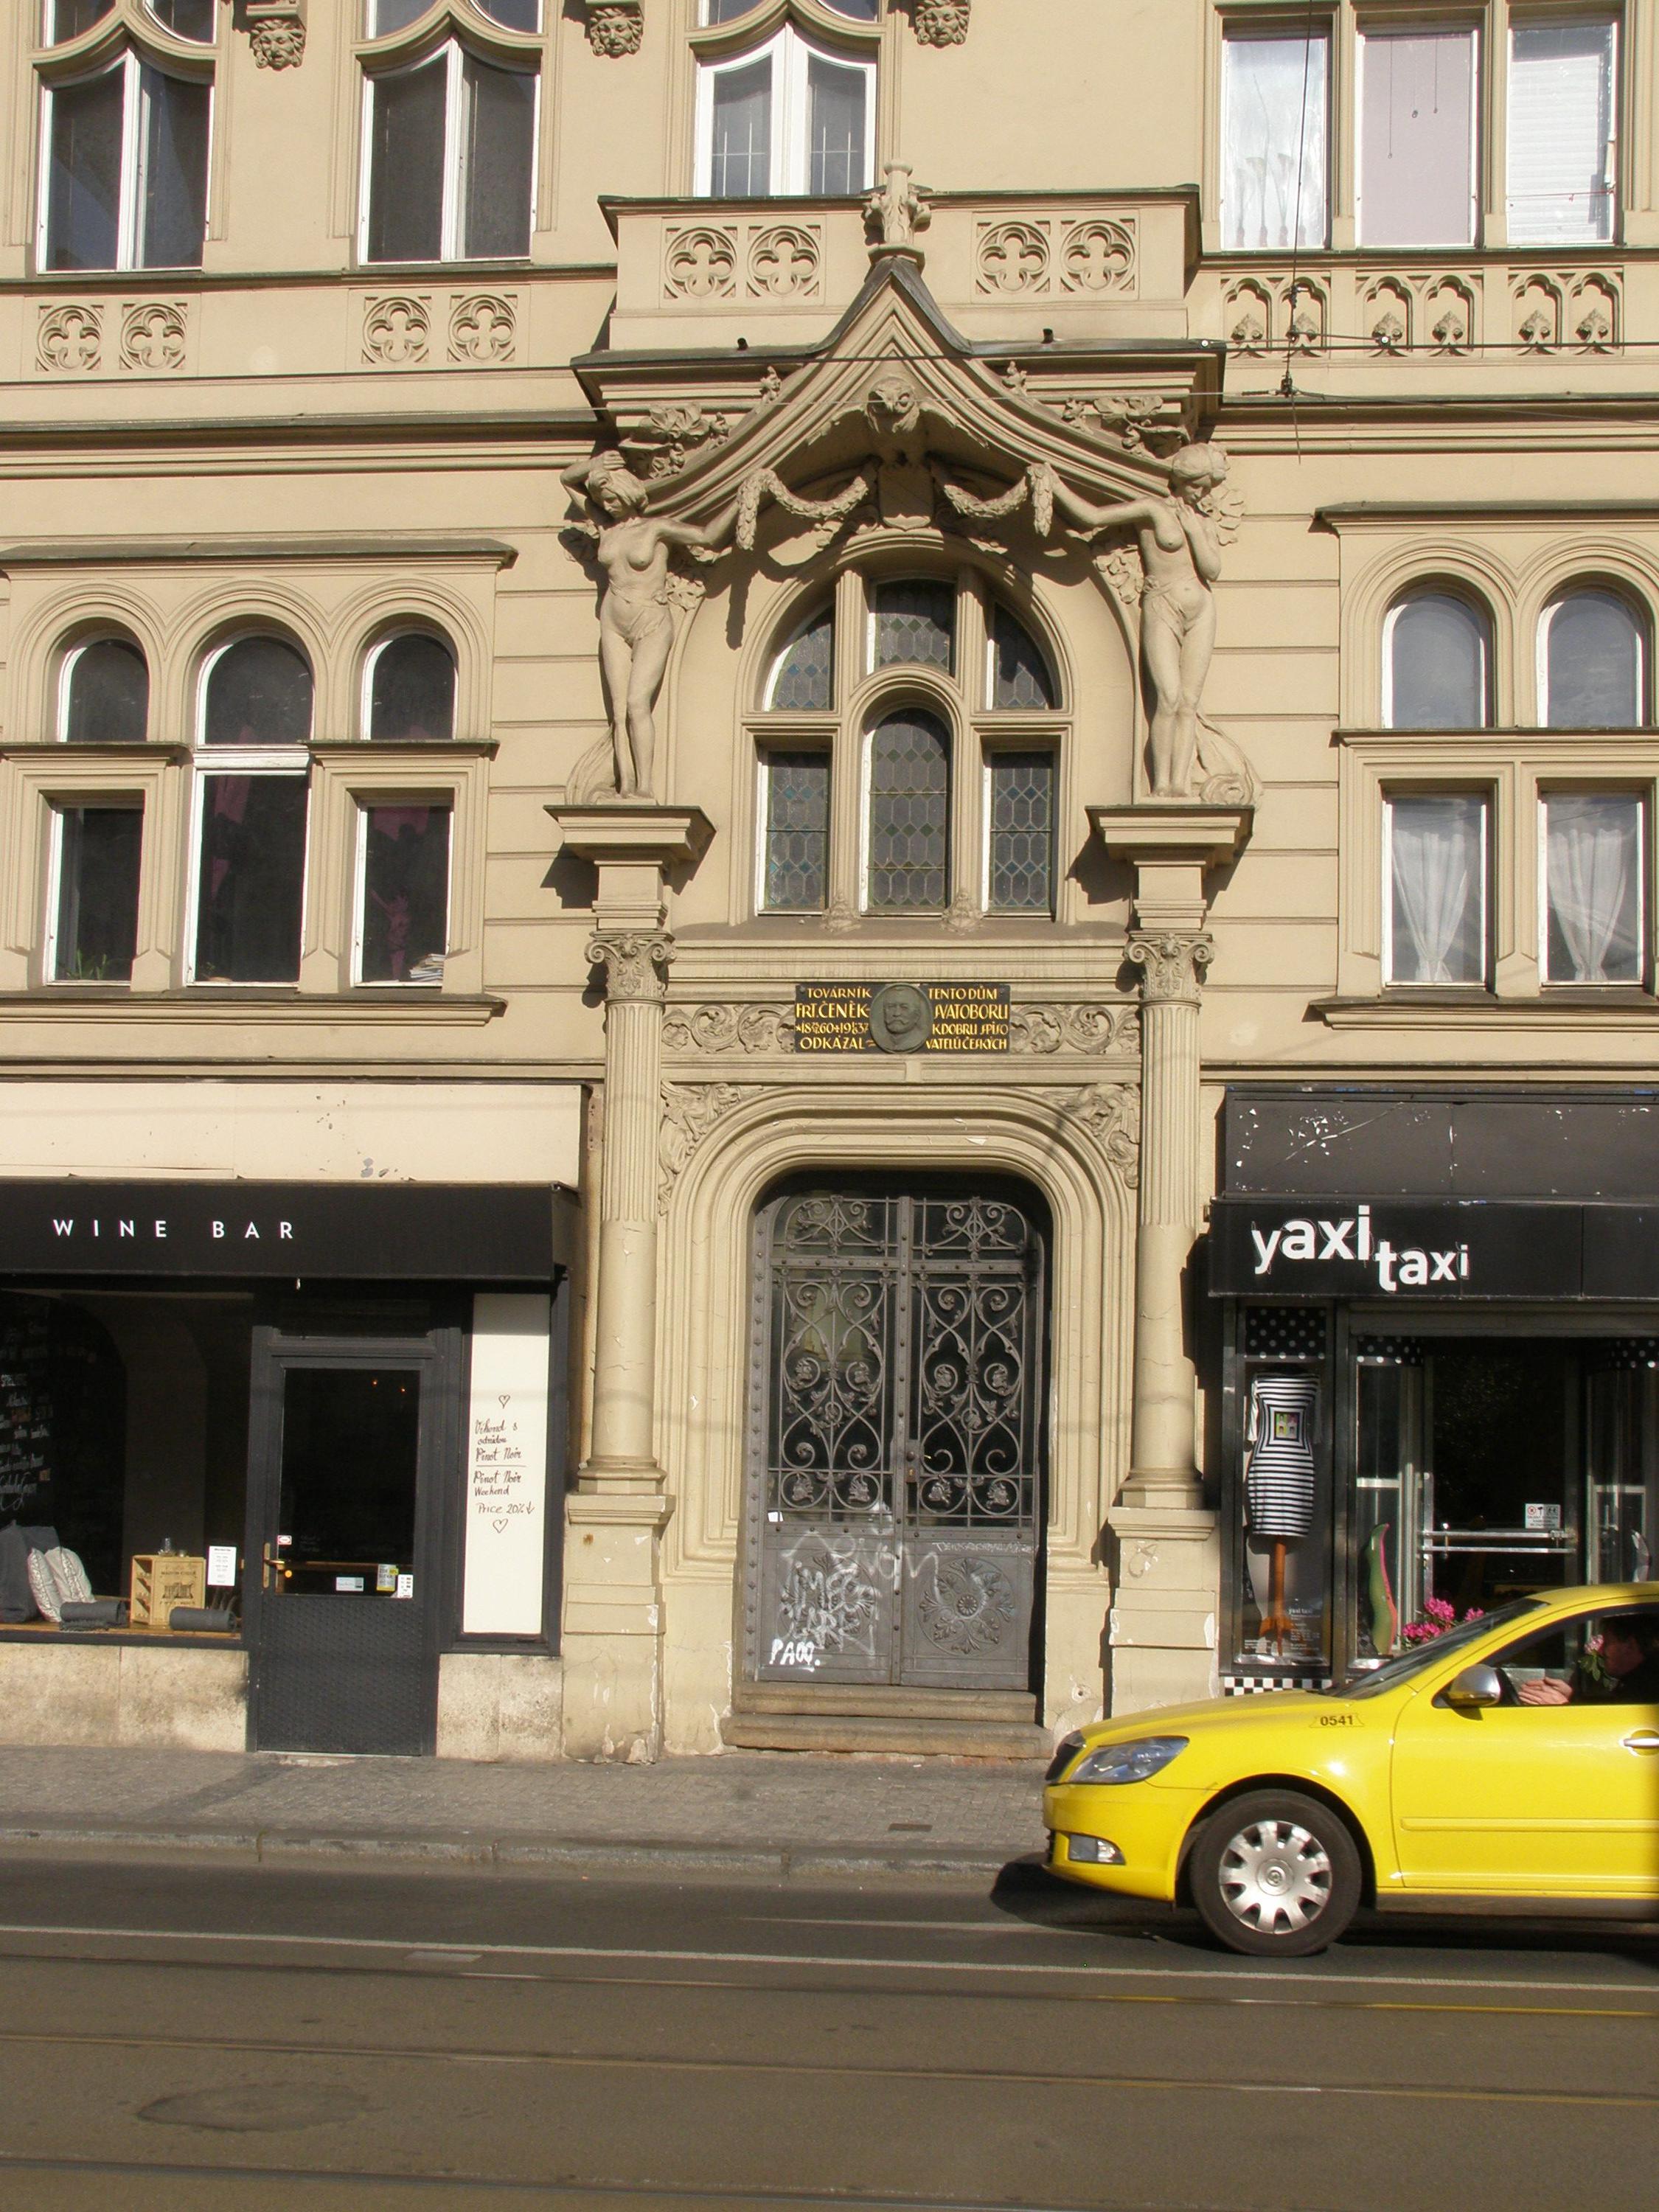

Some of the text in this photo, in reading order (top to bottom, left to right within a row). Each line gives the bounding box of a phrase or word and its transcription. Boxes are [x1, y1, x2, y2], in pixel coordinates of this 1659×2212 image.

[808, 986, 872, 998] TOVÁRNÍK
[929, 988, 966, 1000] TENTO
[934, 1004, 1008, 1019] SVATOBORU
[942, 1023, 978, 1035] DOBRU
[53, 1219, 293, 1239] WINE BAR
[1251, 1205, 1370, 1275] yaxi
[1374, 1241, 1468, 1292] taxi
[476, 1447, 521, 1461] Pinot Noir
[473, 1470, 521, 1484] Pinot Noir
[474, 1484, 510, 1497] Weekend
[476, 1502, 525, 1514] Price 20%
[1320, 1715, 1353, 1726] 0541
